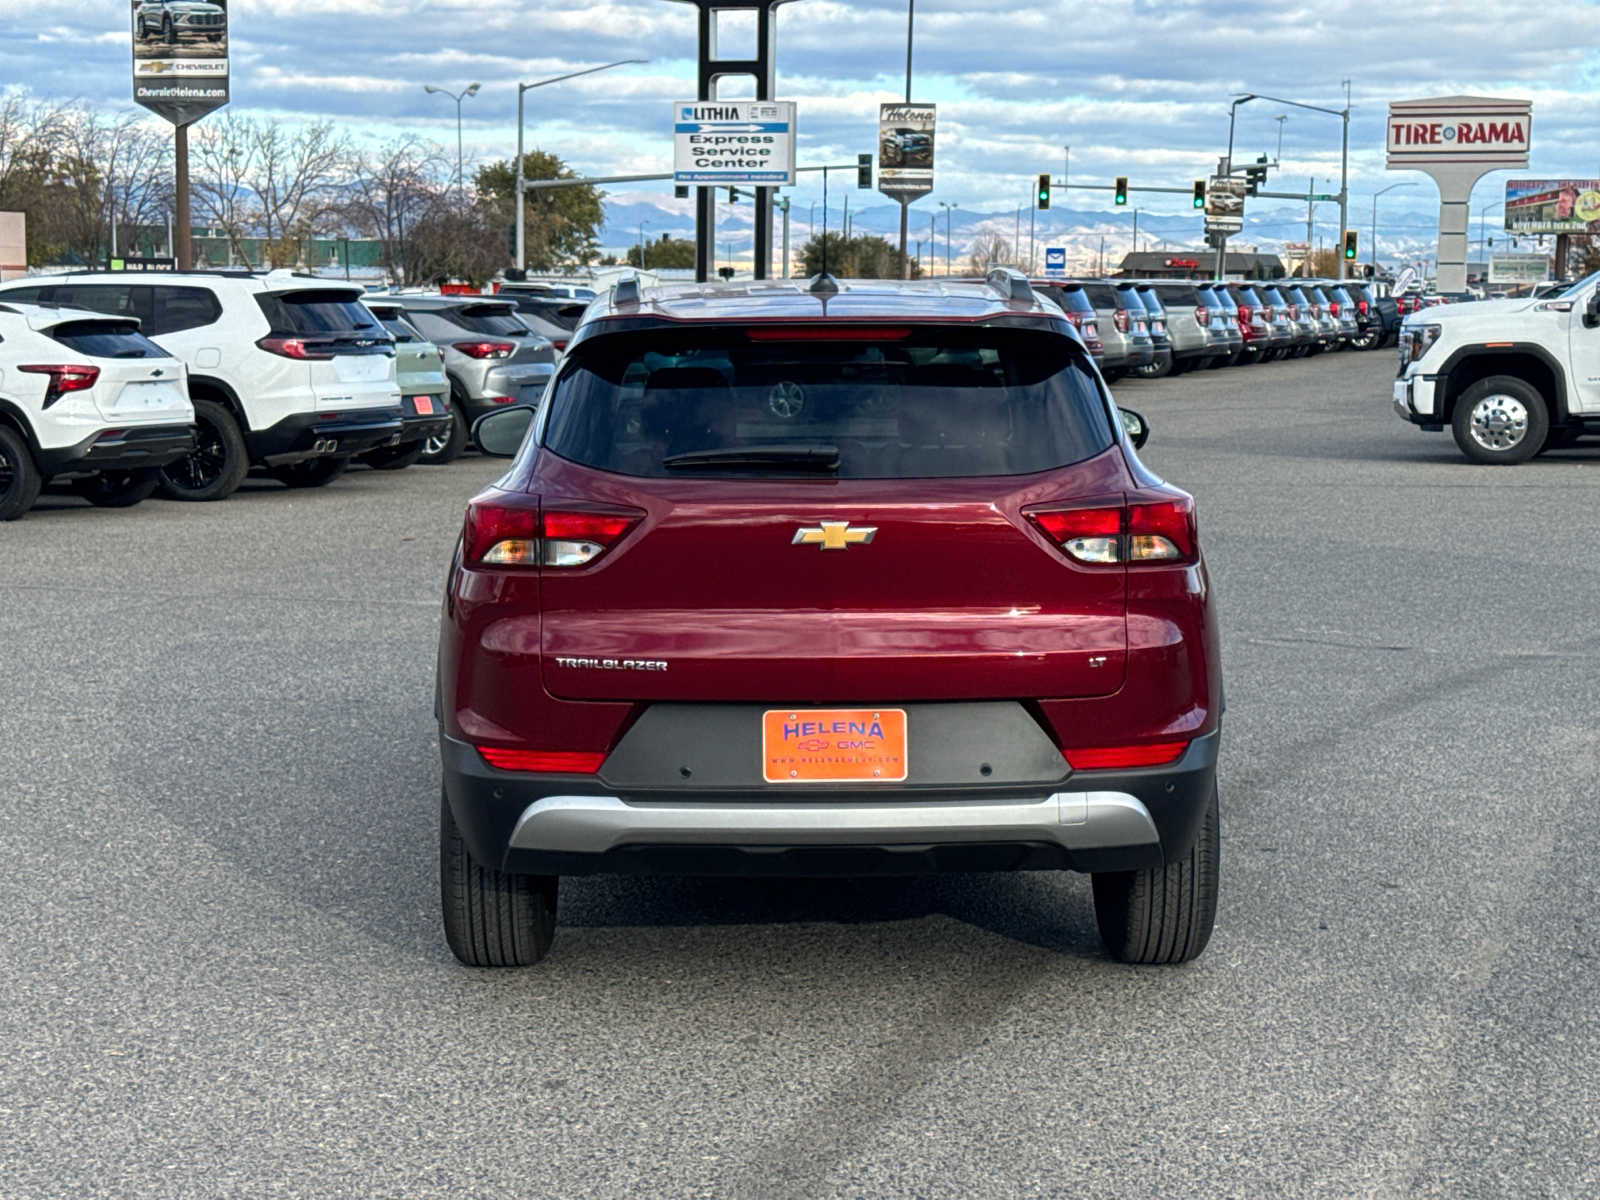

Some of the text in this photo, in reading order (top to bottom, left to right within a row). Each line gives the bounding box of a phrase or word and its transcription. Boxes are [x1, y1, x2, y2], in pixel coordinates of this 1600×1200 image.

[175, 63, 225, 71] CHEVROLET
[137, 87, 227, 97] ChevroletHelena.com
[694, 107, 740, 121] LITHIA
[1391, 121, 1525, 145] TIRE RAMA
[689, 135, 775, 146] Express
[691, 146, 772, 156] Service
[695, 158, 769, 168] Center
[555, 657, 668, 671] TRAILBLAZER
[1089, 656, 1107, 667] LT
[783, 721, 884, 741] HELENA
[836, 741, 876, 750] GMC
